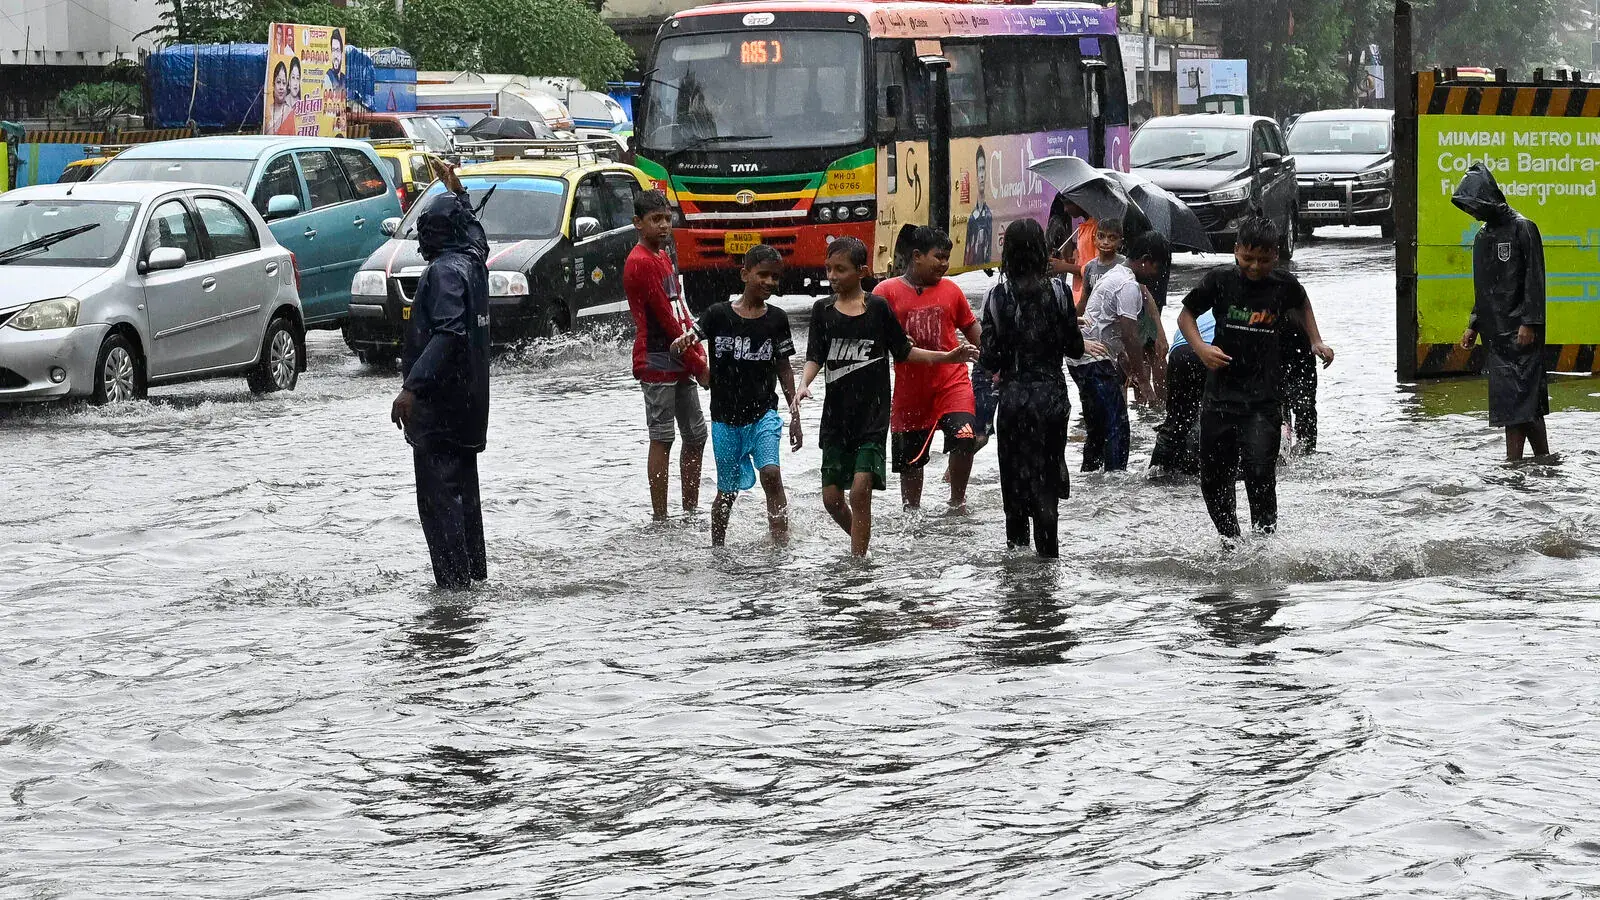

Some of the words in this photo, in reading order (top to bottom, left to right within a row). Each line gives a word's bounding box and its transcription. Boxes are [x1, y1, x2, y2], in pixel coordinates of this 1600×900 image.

[1438, 131, 1506, 146] MUMBAI
[1513, 131, 1572, 146] METRO
[1576, 131, 1600, 146] LIN
[731, 163, 759, 173] TATA
[1437, 152, 1510, 173] Colba
[1497, 179, 1597, 206] nderground
[714, 335, 773, 361] FILA
[827, 338, 875, 361] NIKE
